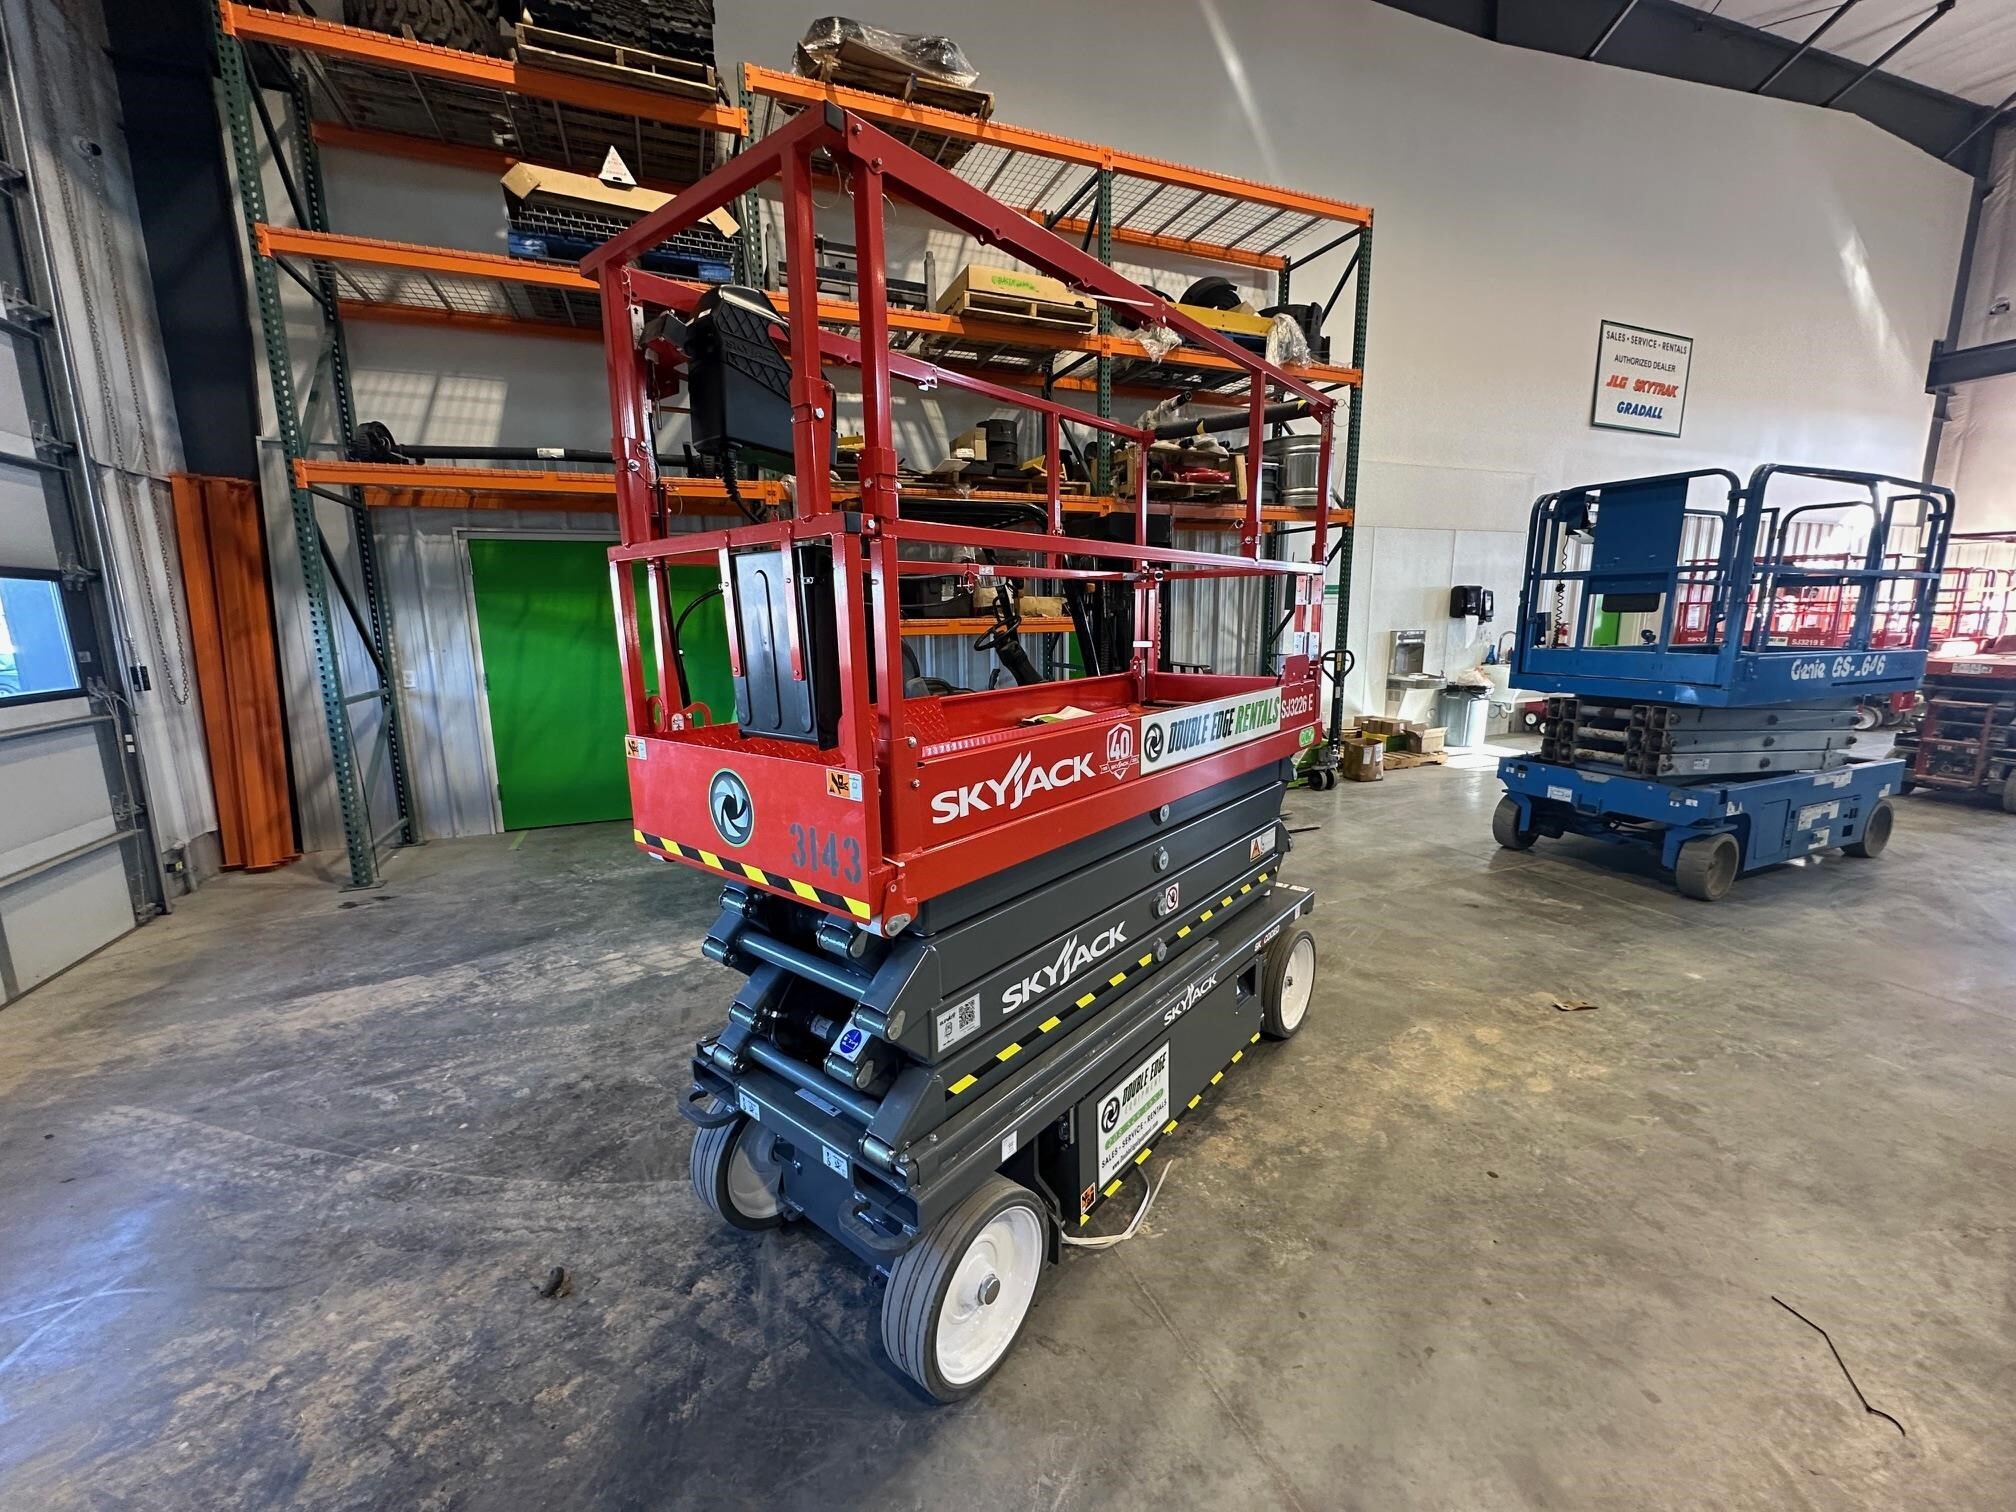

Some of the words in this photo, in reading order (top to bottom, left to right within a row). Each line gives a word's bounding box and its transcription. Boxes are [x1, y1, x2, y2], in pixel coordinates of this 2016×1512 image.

[1606, 330, 1626, 343] SALES
[1631, 335, 1657, 349] SERVICE
[1662, 342, 1687, 355] RENTALS
[1614, 354, 1652, 369] AUTHORIZED
[1653, 361, 1676, 373] DEALER
[1606, 375, 1629, 389] JLG
[1633, 379, 1678, 398] SKYTRAK
[1617, 401, 1663, 419] GRADALL
[1791, 659, 1826, 680] Genie
[1167, 714, 1210, 754] DOUBLE
[1210, 708, 1235, 741] EDGE
[1235, 696, 1280, 734] RENTALS
[1281, 698, 1307, 719] SJ3226
[1110, 730, 1130, 760] 40
[931, 750, 1097, 825] SKYJACK
[789, 822, 862, 884] 3143
[1001, 920, 1128, 1015] SKYJACK
[1163, 973, 1218, 1027] SKYJACK
[1122, 1067, 1149, 1107] DOUBLE
[1150, 1051, 1167, 1082] EDGE
[1101, 1149, 1119, 1169] SALES
[1122, 1120, 1144, 1148] SERVICE
[1147, 1099, 1167, 1123] RENTALS
